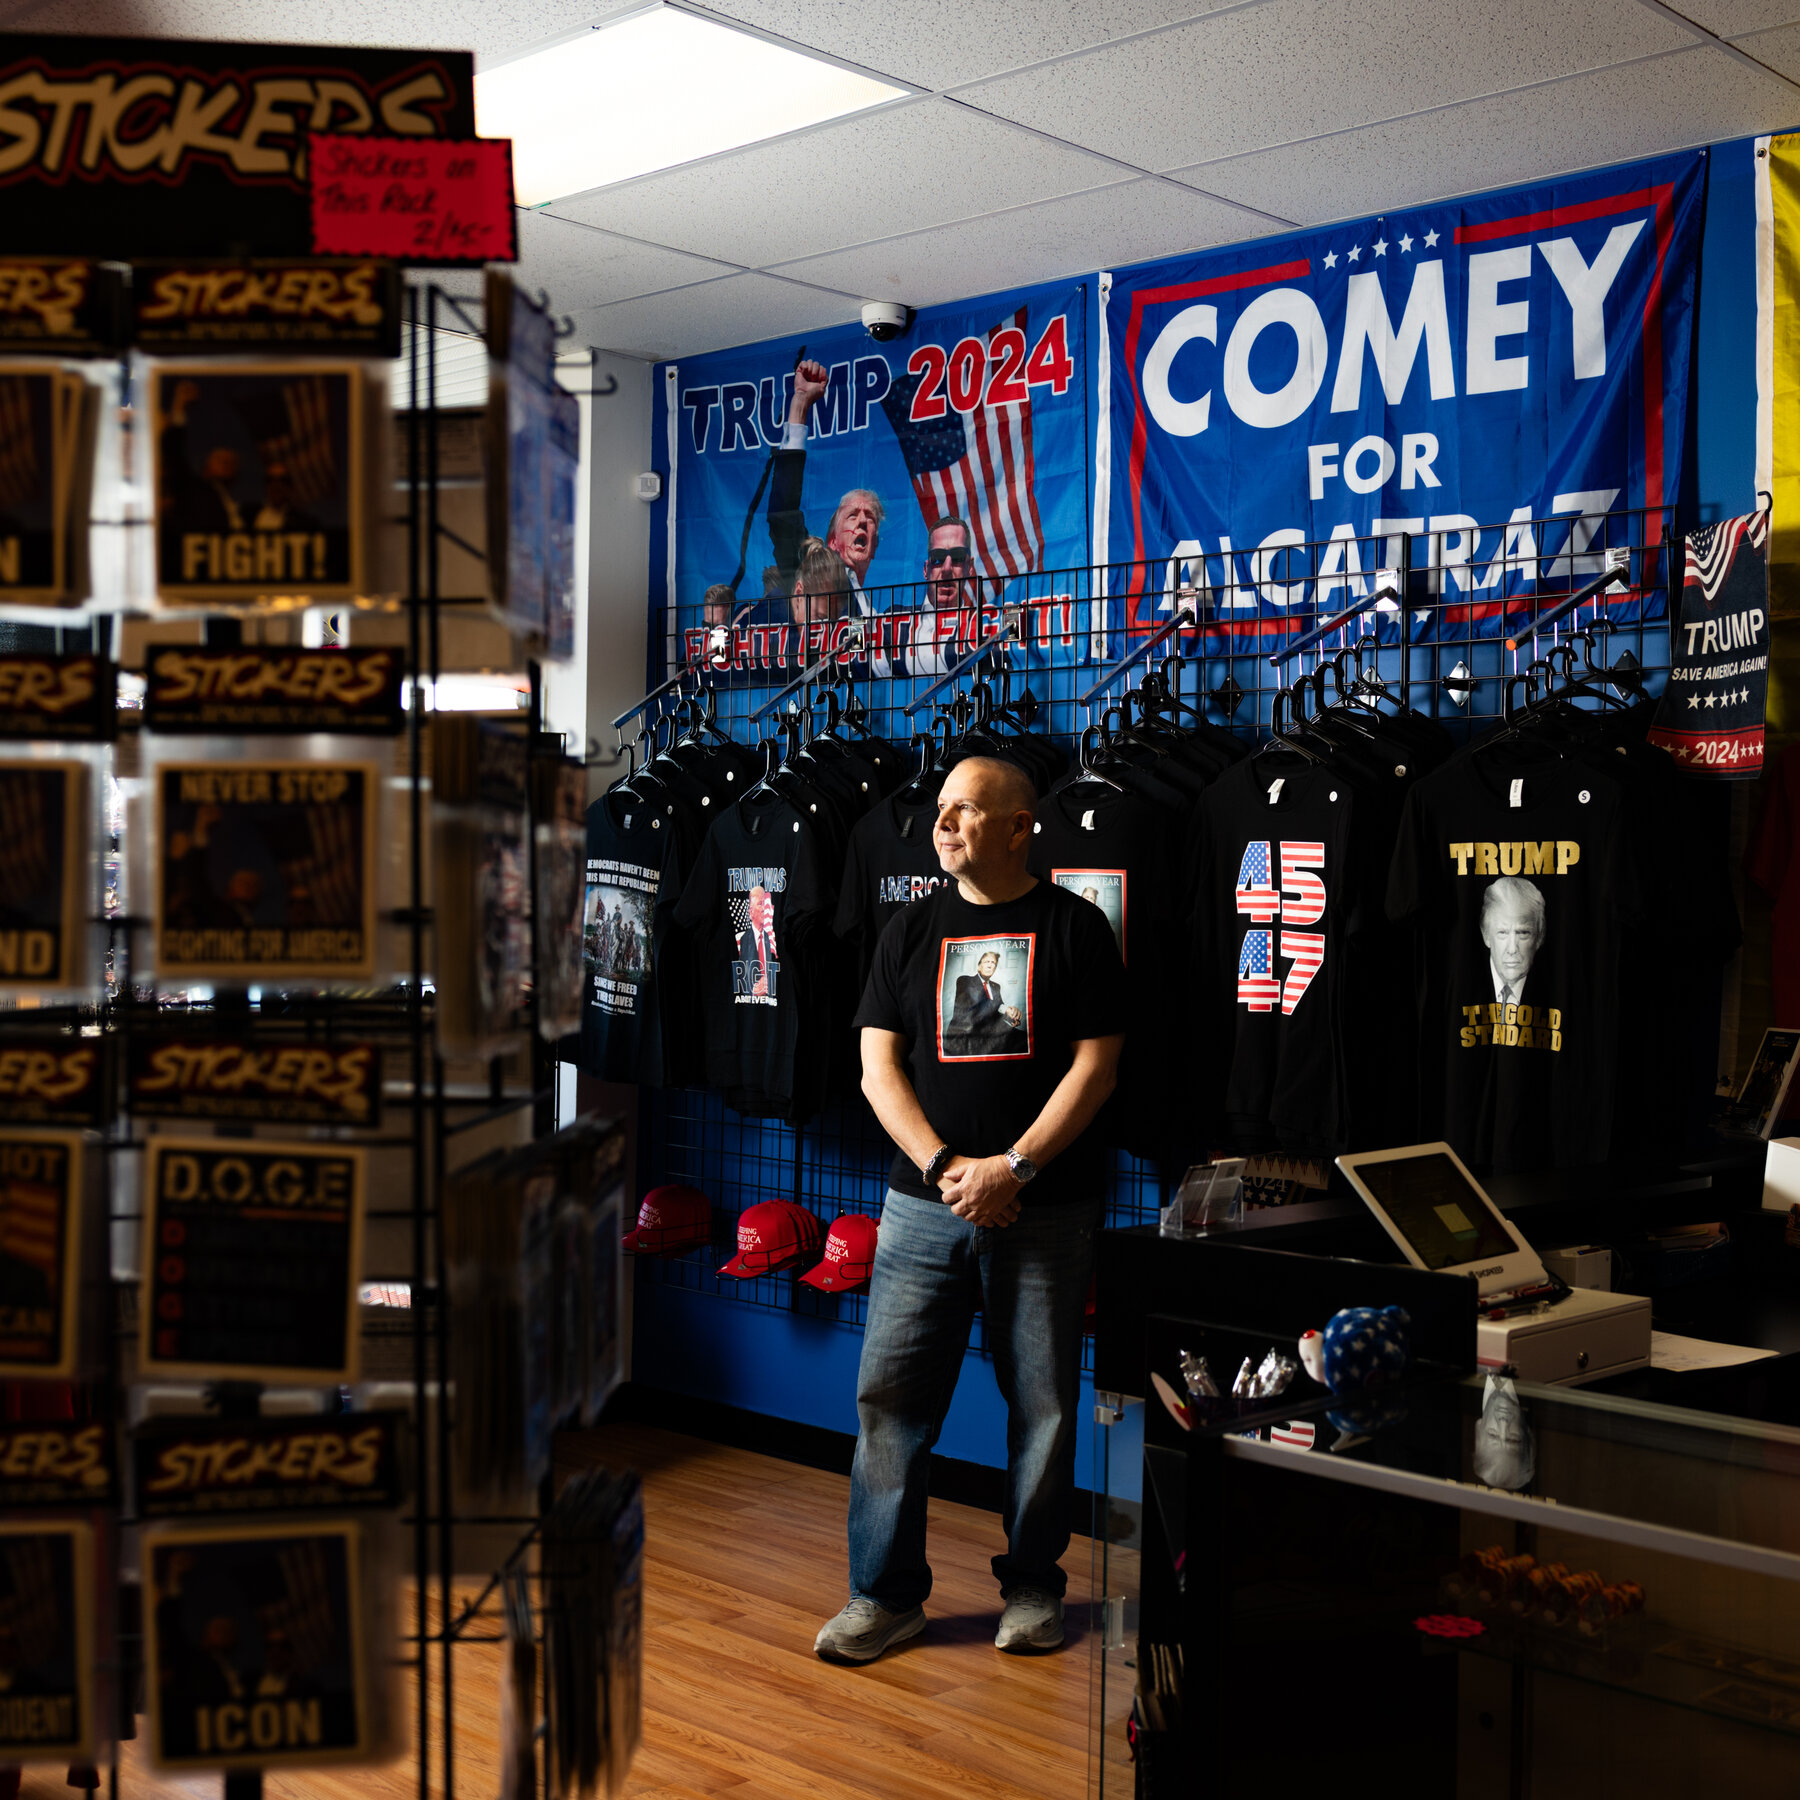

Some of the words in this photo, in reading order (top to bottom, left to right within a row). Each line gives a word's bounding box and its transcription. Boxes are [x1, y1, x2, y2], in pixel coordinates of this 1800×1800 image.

[140, 262, 379, 320] STICKERS
[1143, 219, 1647, 438] COMEY
[683, 354, 892, 454] TRUMP
[907, 314, 1074, 422] 2024
[1309, 432, 1442, 501] FOR
[182, 534, 328, 581] FIGHT!
[1159, 488, 1621, 612] ALCATRAZ
[1684, 608, 1765, 656] TRUMP
[153, 650, 391, 706] STICKERS
[1672, 666, 1702, 681] SAVE
[1704, 661, 1738, 680] AMERICA
[1739, 655, 1767, 673] AGAIN!
[1691, 740, 1739, 764] 2024
[179, 774, 268, 803] NEVER
[282, 773, 350, 802] STOP
[728, 867, 763, 892] TRUMP
[763, 867, 787, 893] WAS
[1235, 841, 1326, 925] 45
[1449, 841, 1581, 876] TRUMP
[879, 875, 948, 903] AMERIC
[1237, 929, 1325, 1015] 47
[1462, 1002, 1502, 1026] THE
[1505, 1003, 1562, 1030] GOLD
[135, 1044, 373, 1101] STICKERS
[144, 1425, 383, 1493] STICKERS
[195, 1697, 324, 1754] ICON
